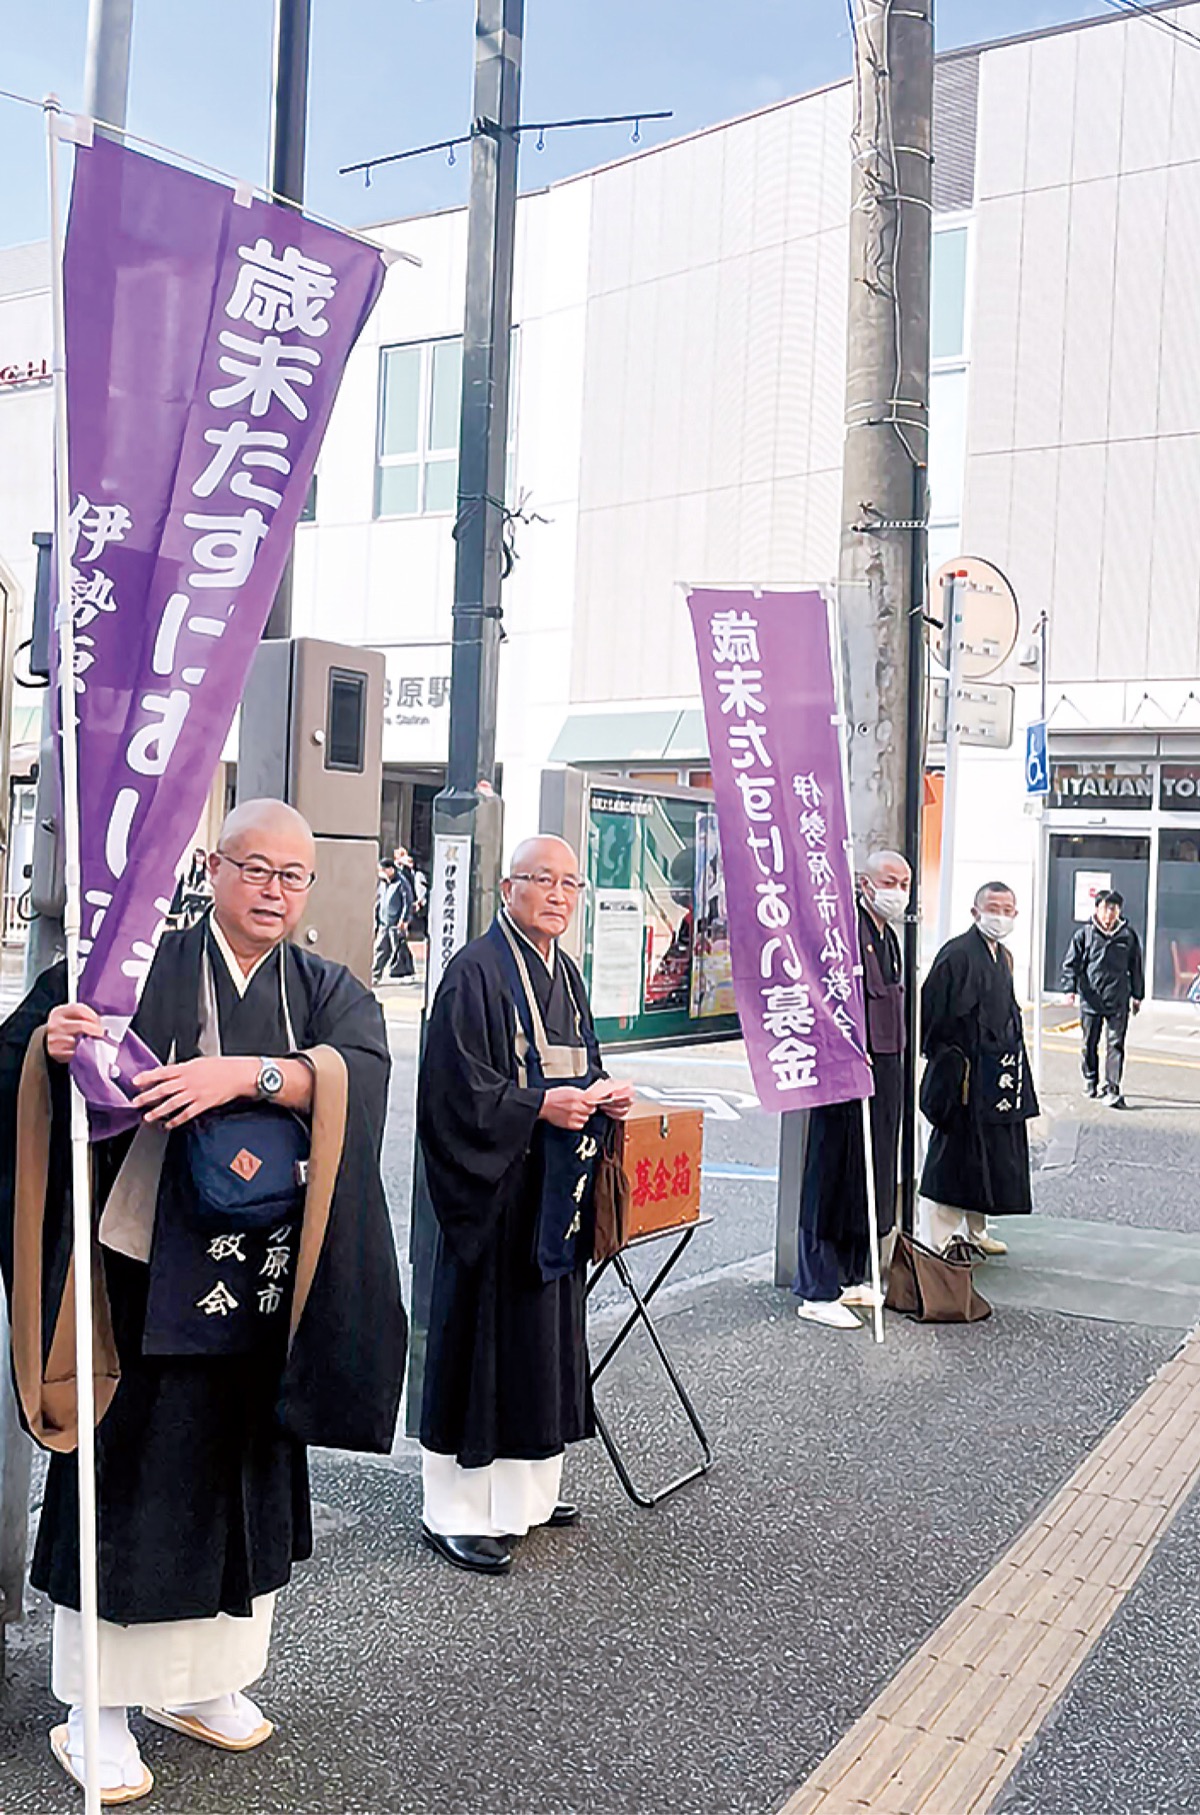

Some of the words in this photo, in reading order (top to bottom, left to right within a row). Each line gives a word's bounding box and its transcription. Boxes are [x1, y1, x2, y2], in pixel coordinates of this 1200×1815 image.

[1061, 777, 1153, 797] ITALIAN
[631, 1151, 692, 1208] 募金箱
